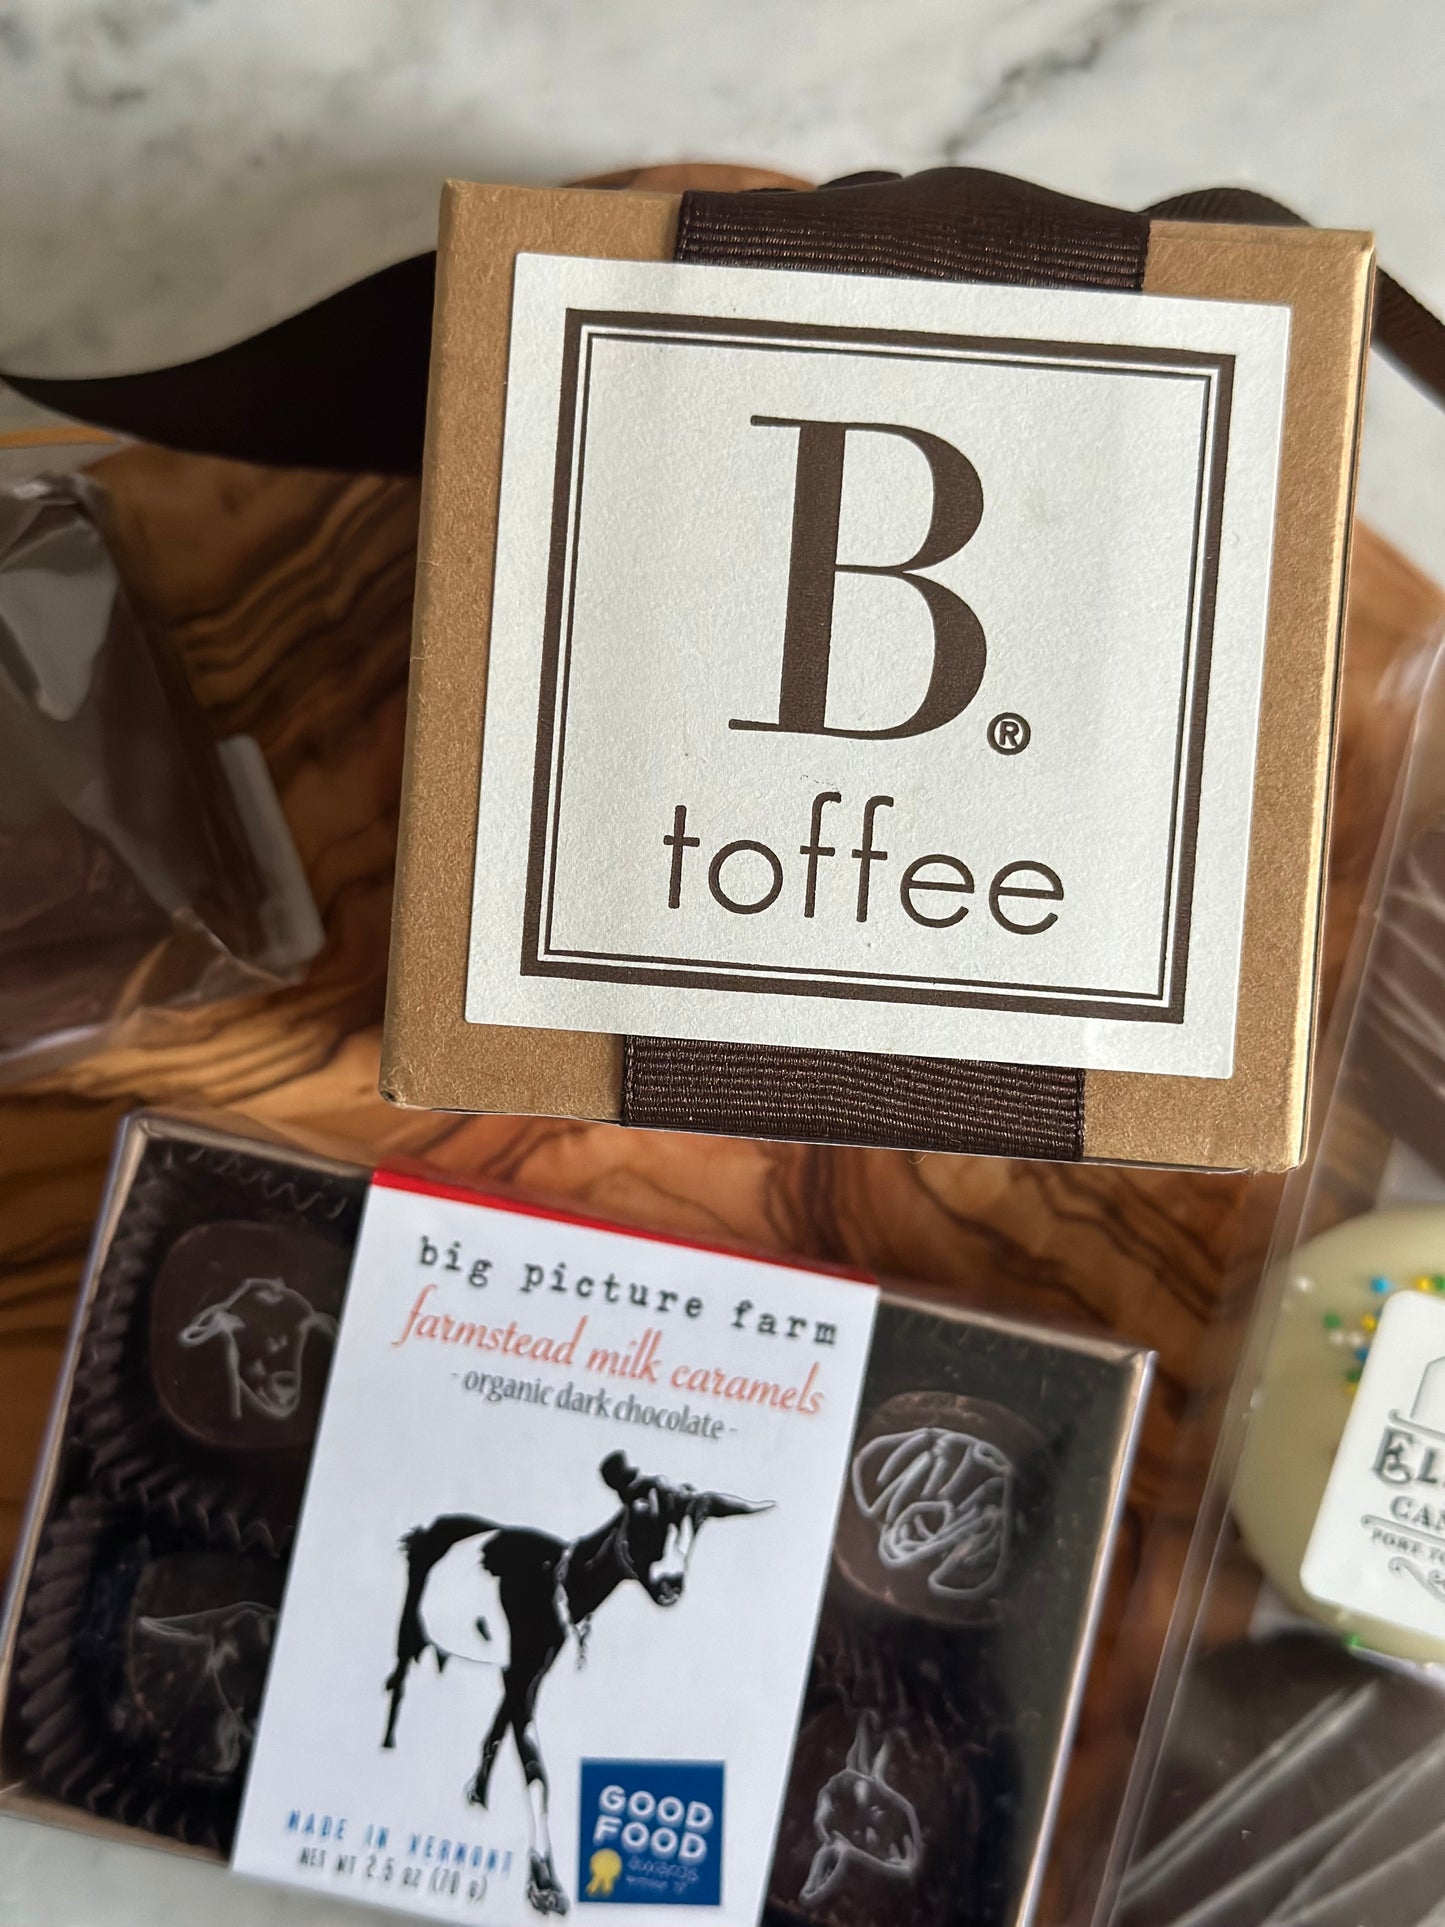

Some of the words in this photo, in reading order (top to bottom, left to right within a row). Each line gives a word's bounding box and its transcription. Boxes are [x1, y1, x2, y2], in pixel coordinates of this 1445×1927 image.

[663, 791, 1064, 935] toffee
[418, 1235, 492, 1288] big
[520, 1261, 703, 1318] picture
[731, 1299, 838, 1346] farm
[391, 1283, 588, 1365] farmstead
[586, 1327, 662, 1383] milk
[670, 1361, 825, 1415] caramels
[464, 1370, 554, 1405] organic
[556, 1381, 610, 1418] dark
[612, 1394, 725, 1440] chocolate
[1371, 1425, 1445, 1487] EL
[286, 1809, 348, 1840] MADE
[365, 1823, 390, 1850] IN
[409, 1832, 514, 1875] VERMONT
[592, 1814, 708, 1866] FOOD
[598, 1784, 714, 1834] GOOD
[299, 1847, 327, 1868] NET
